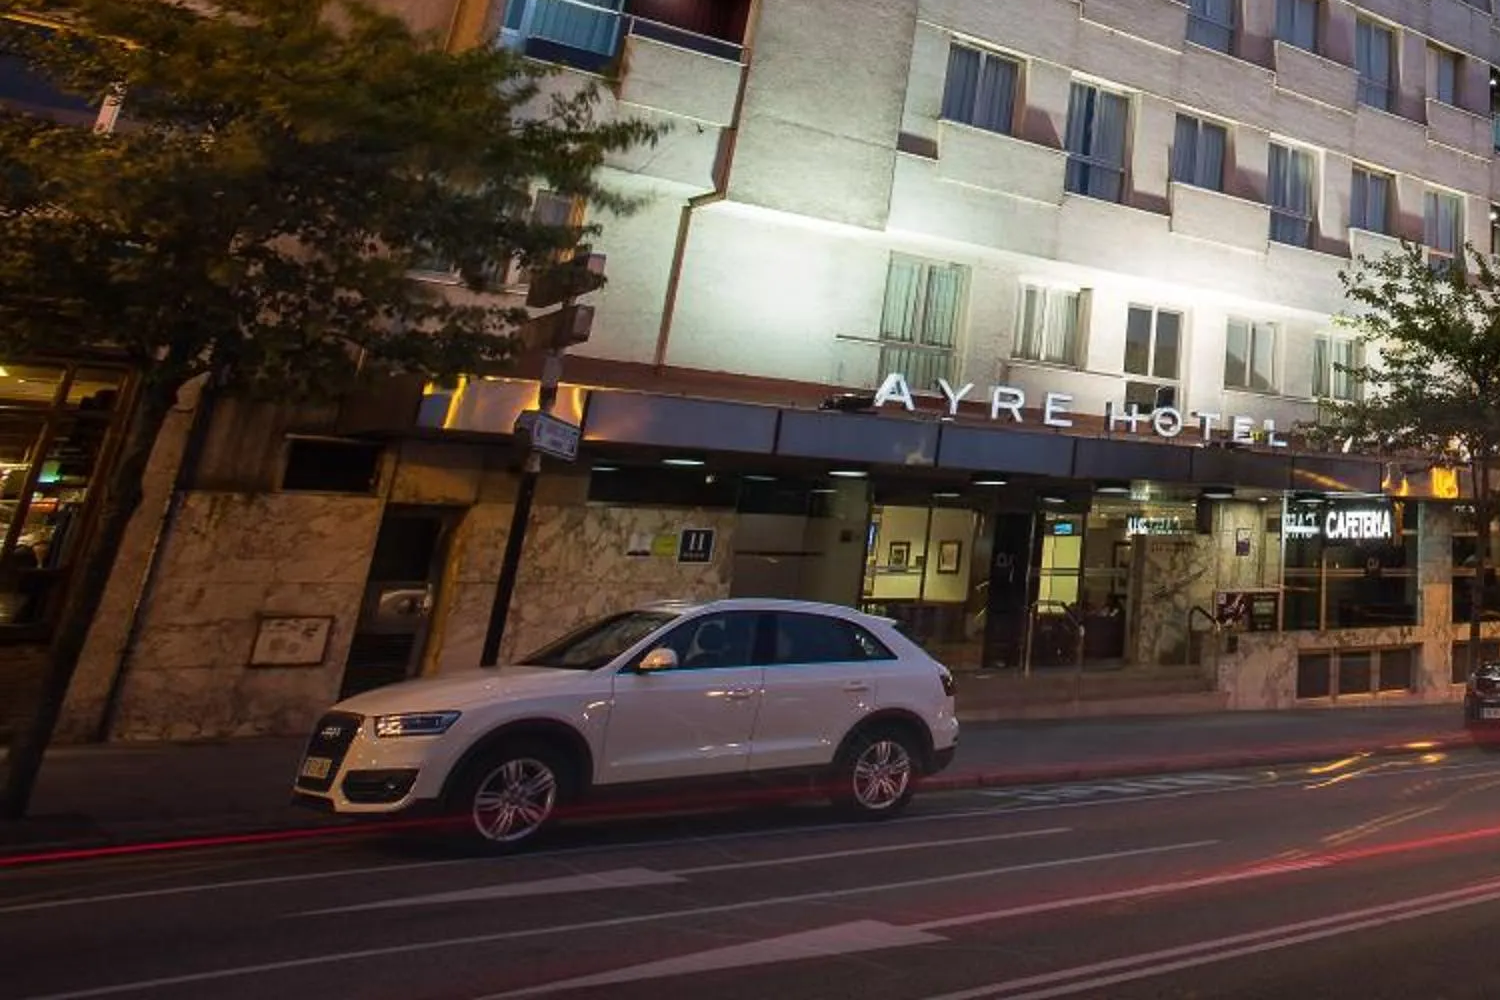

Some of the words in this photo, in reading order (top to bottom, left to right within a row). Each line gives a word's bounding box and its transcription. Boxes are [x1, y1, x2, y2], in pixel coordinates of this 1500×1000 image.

[874, 373, 1073, 427] AYRE
[1107, 402, 1288, 447] HOTEL
[1325, 510, 1392, 538] CAFETERIA
